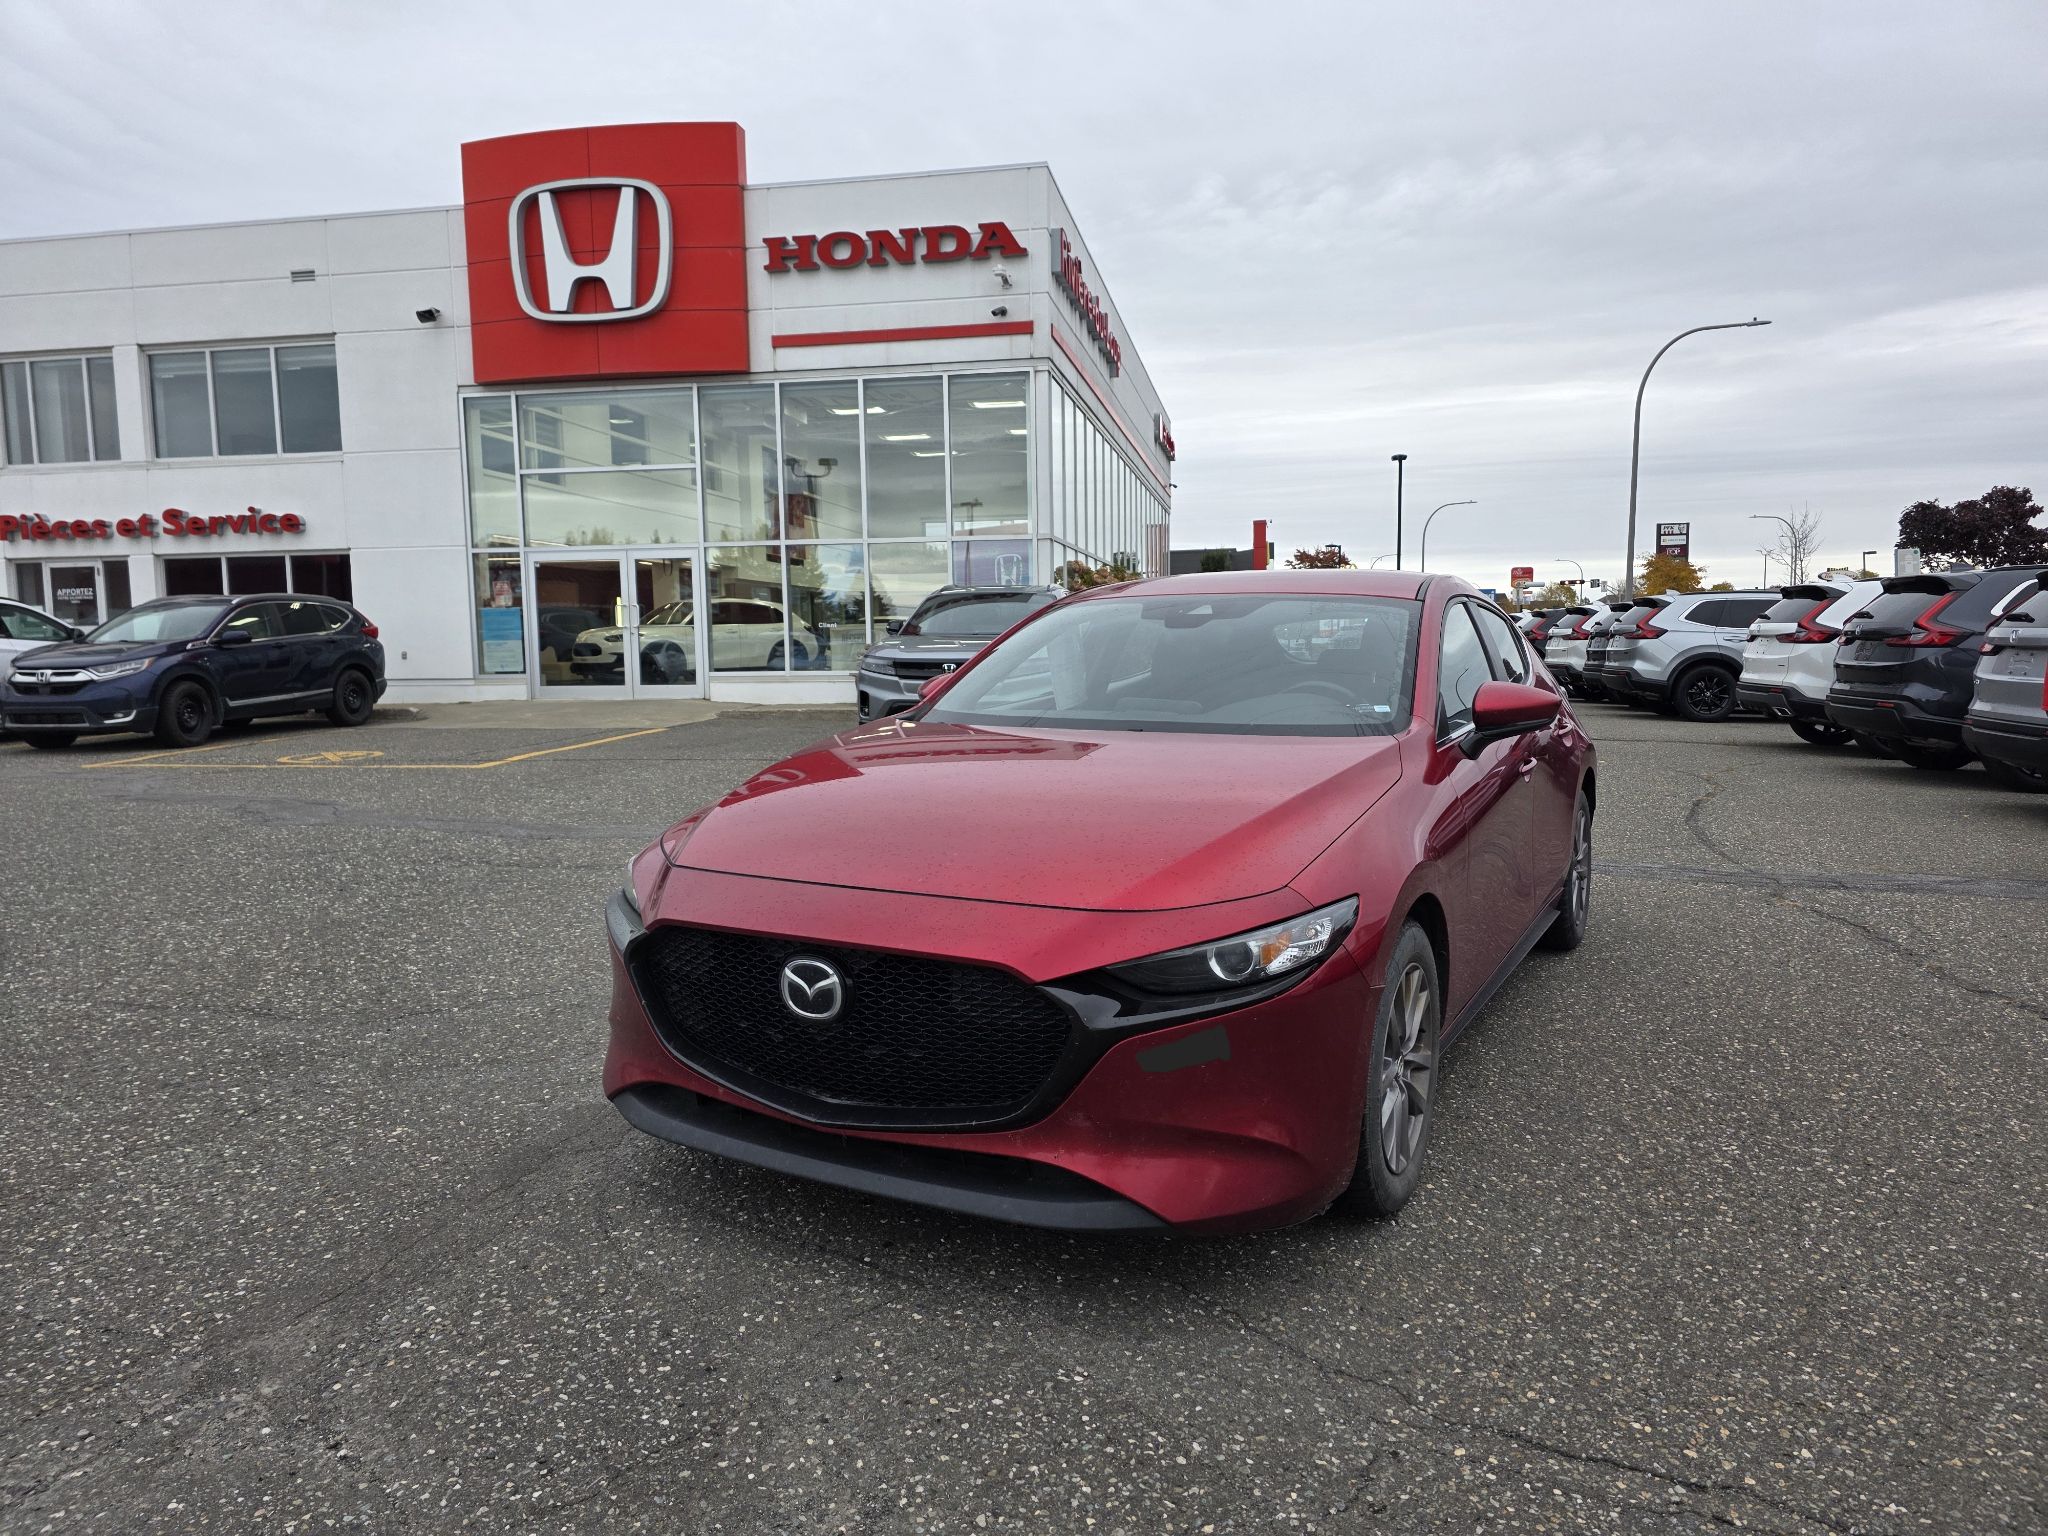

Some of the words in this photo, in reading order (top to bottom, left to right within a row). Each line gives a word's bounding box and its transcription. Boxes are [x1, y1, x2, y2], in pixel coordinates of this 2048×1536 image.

[763, 222, 1028, 272] HONDA
[0, 513, 108, 541] Pièces
[116, 513, 154, 538] et
[162, 506, 302, 536] Service
[57, 588, 93, 596] APPORTEZ
